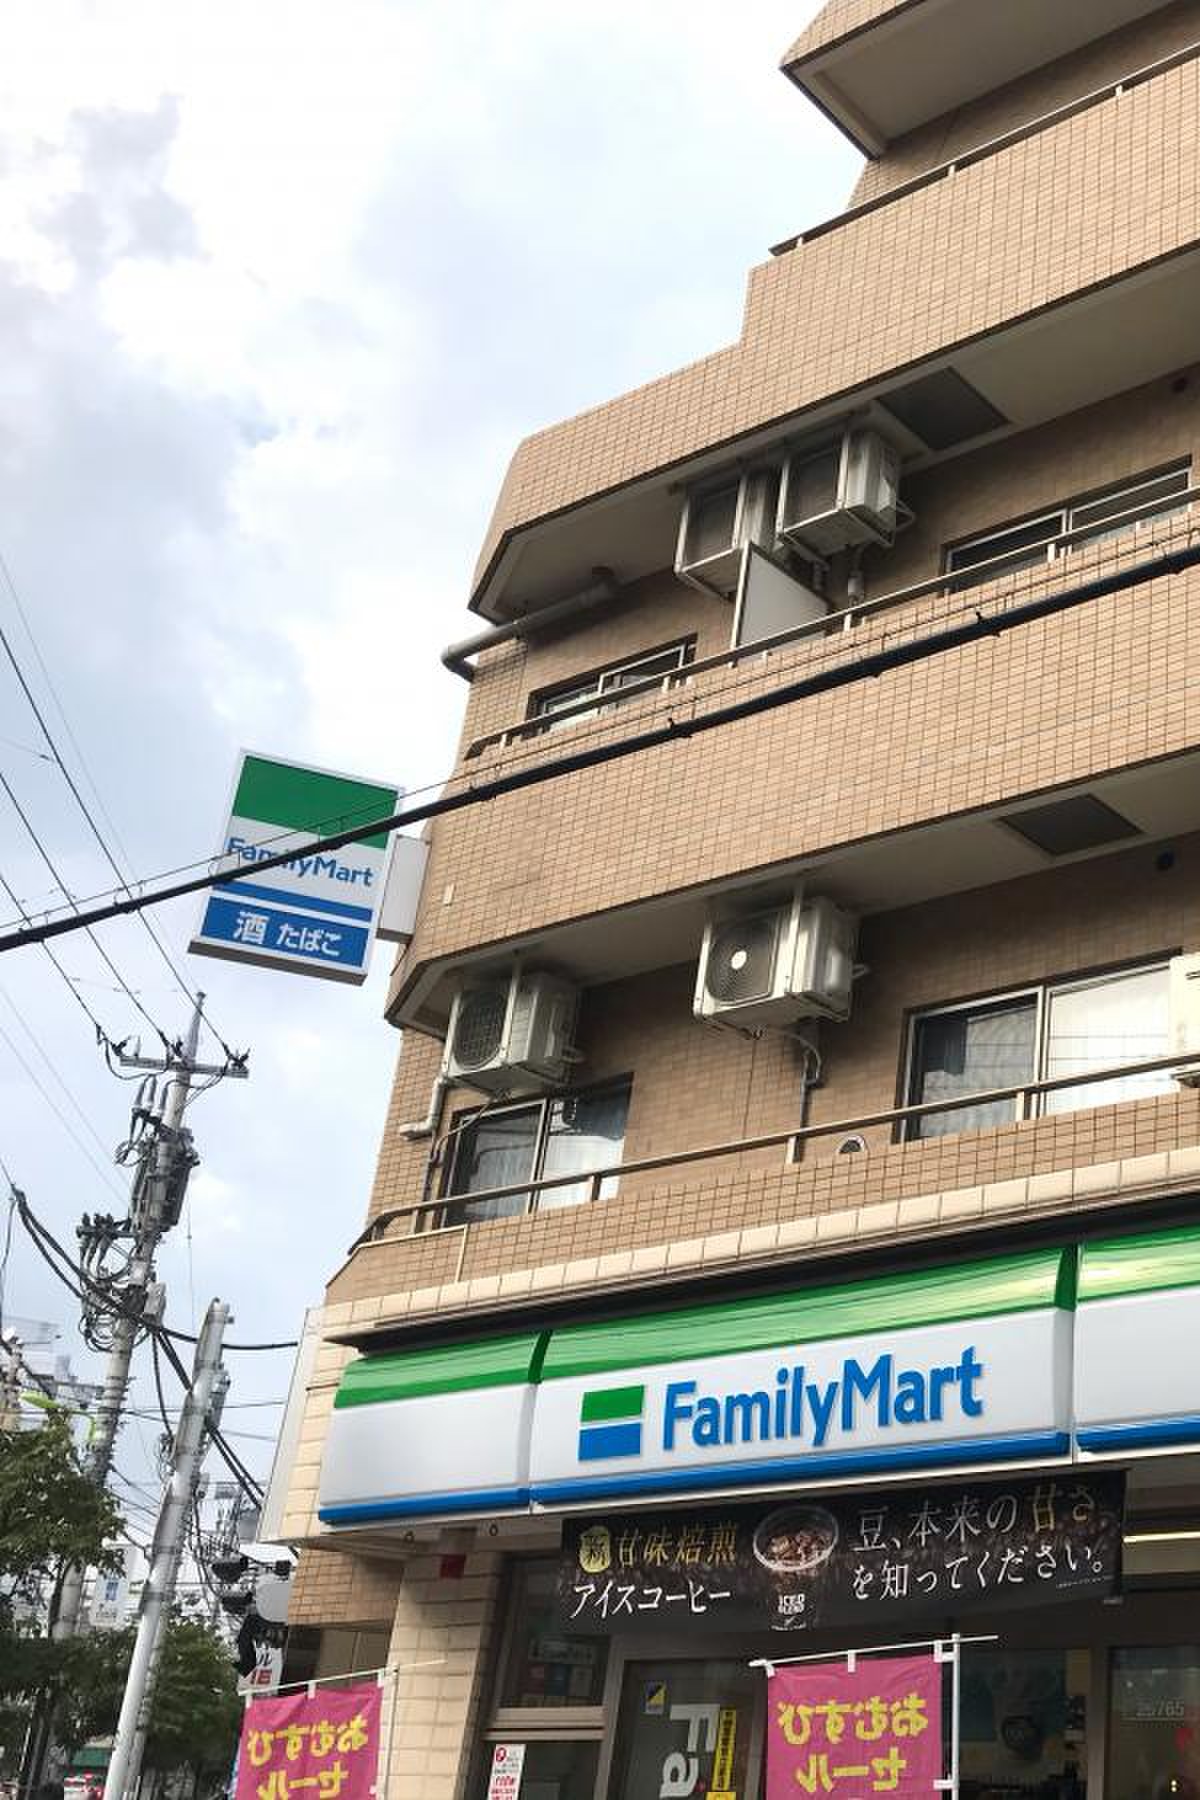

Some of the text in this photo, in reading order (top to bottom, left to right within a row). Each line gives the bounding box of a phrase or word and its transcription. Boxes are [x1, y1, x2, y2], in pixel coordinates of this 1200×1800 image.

[226, 837, 373, 887] FamyMart
[233, 911, 341, 957] 酒 たばこ
[662, 1345, 983, 1448] FamilyMart
[853, 1483, 1095, 1552] 豆、本来の甘さ
[615, 1520, 738, 1568] 甘味焙煎
[852, 1542, 1104, 1600] を知ってください。
[569, 1580, 732, 1620] アイスコーヒー
